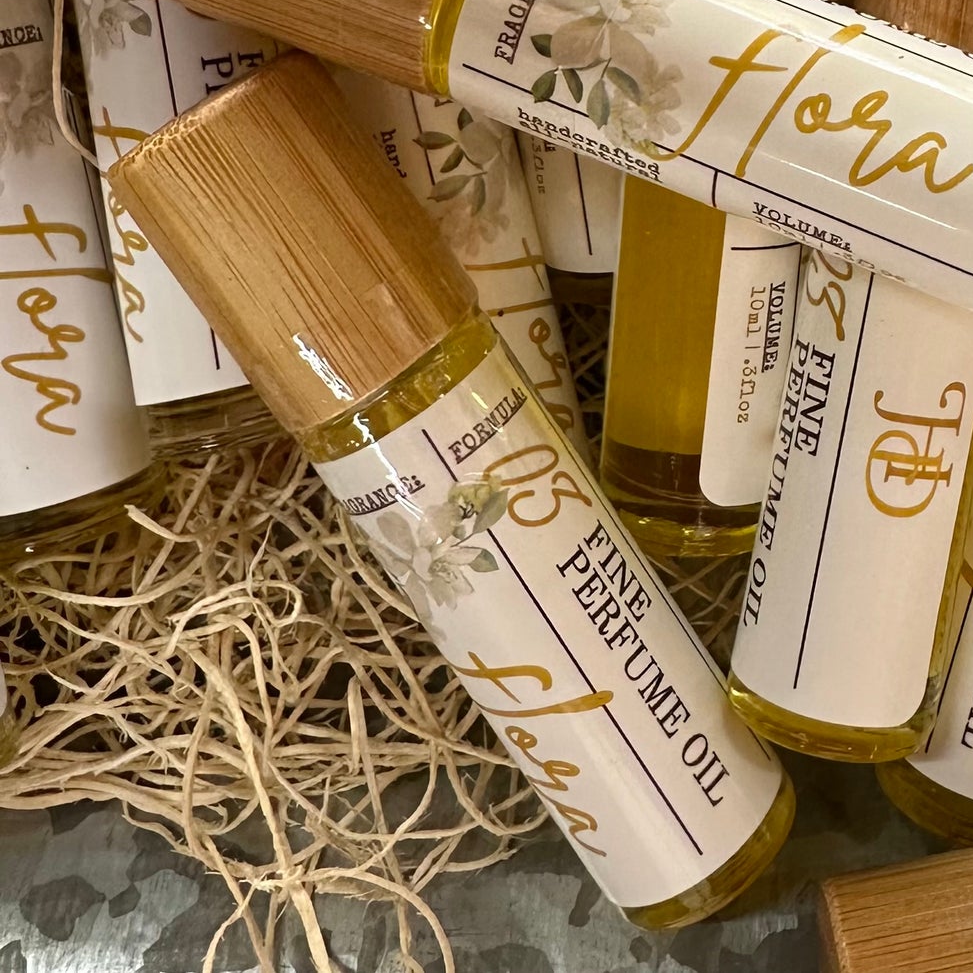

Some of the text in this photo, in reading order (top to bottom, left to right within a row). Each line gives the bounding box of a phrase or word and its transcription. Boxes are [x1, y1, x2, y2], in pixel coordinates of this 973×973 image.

[517, 106, 662, 176] handcrafted
[746, 285, 767, 339] 10ml
[760, 280, 787, 374] VOLUME:
[448, 385, 528, 465] FORMULA:
[794, 343, 836, 458] FINE
[742, 334, 811, 626] PERFUME OIL
[583, 517, 655, 623] FINE
[555, 547, 731, 808] PERFUME OIL
